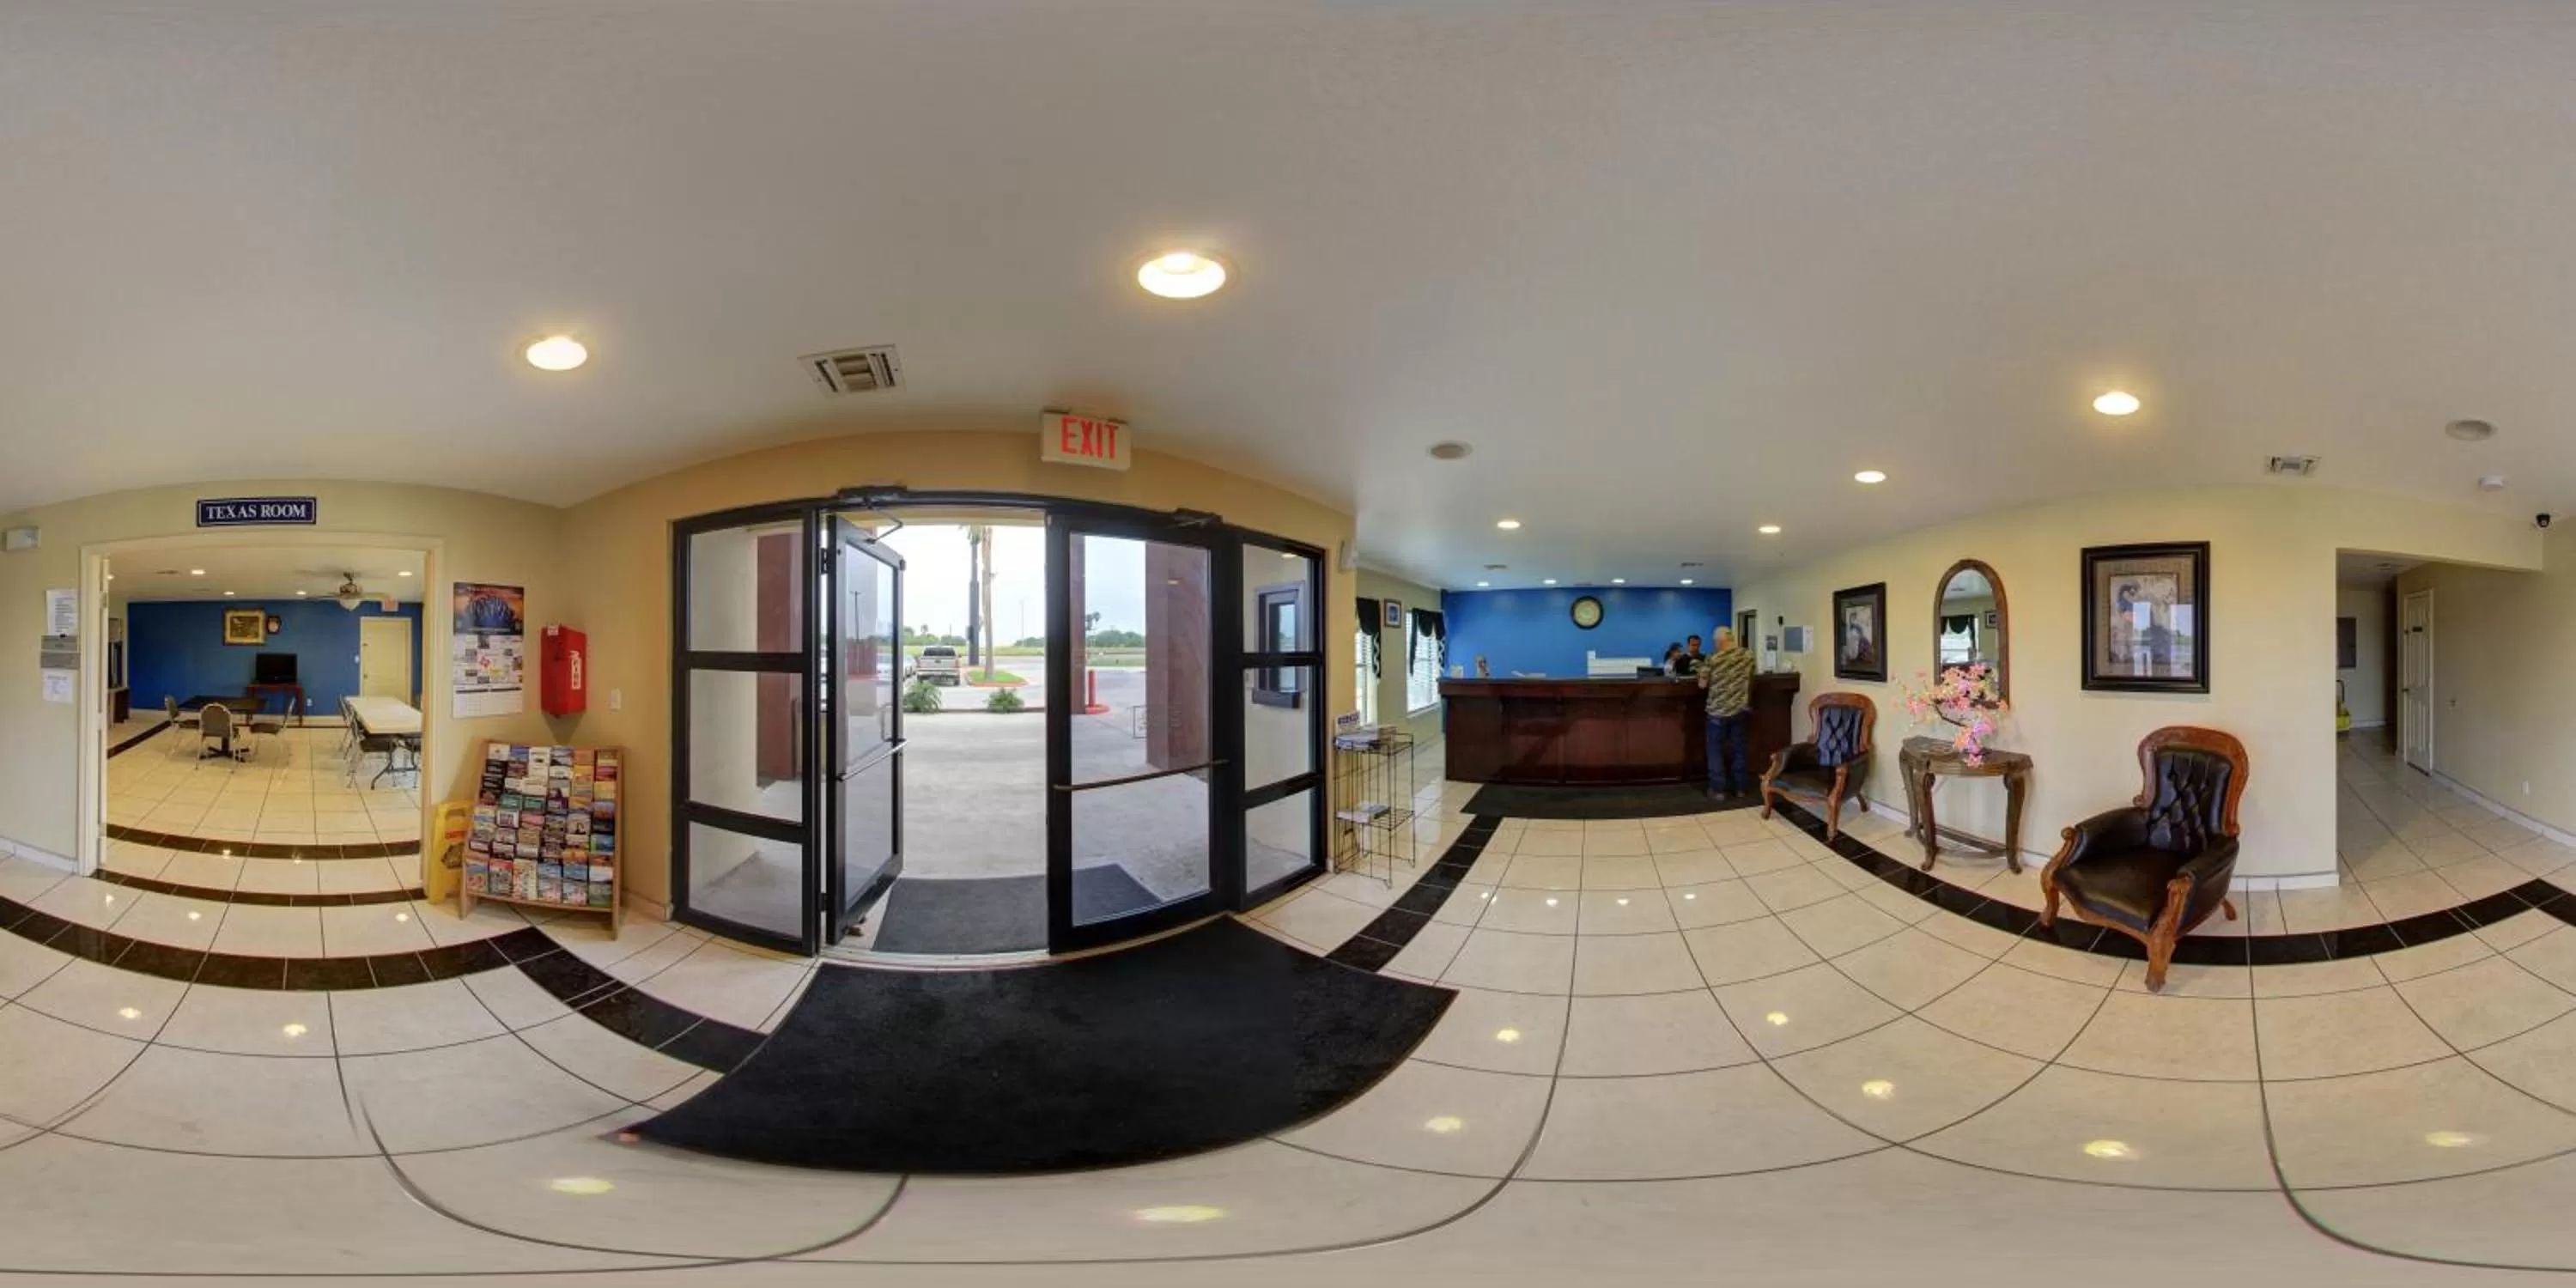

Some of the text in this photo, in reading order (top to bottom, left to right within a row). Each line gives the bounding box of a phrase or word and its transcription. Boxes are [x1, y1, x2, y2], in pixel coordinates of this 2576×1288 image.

[1060, 416, 1120, 460] EXIT
[206, 503, 306, 519] TEXAS ROOM
